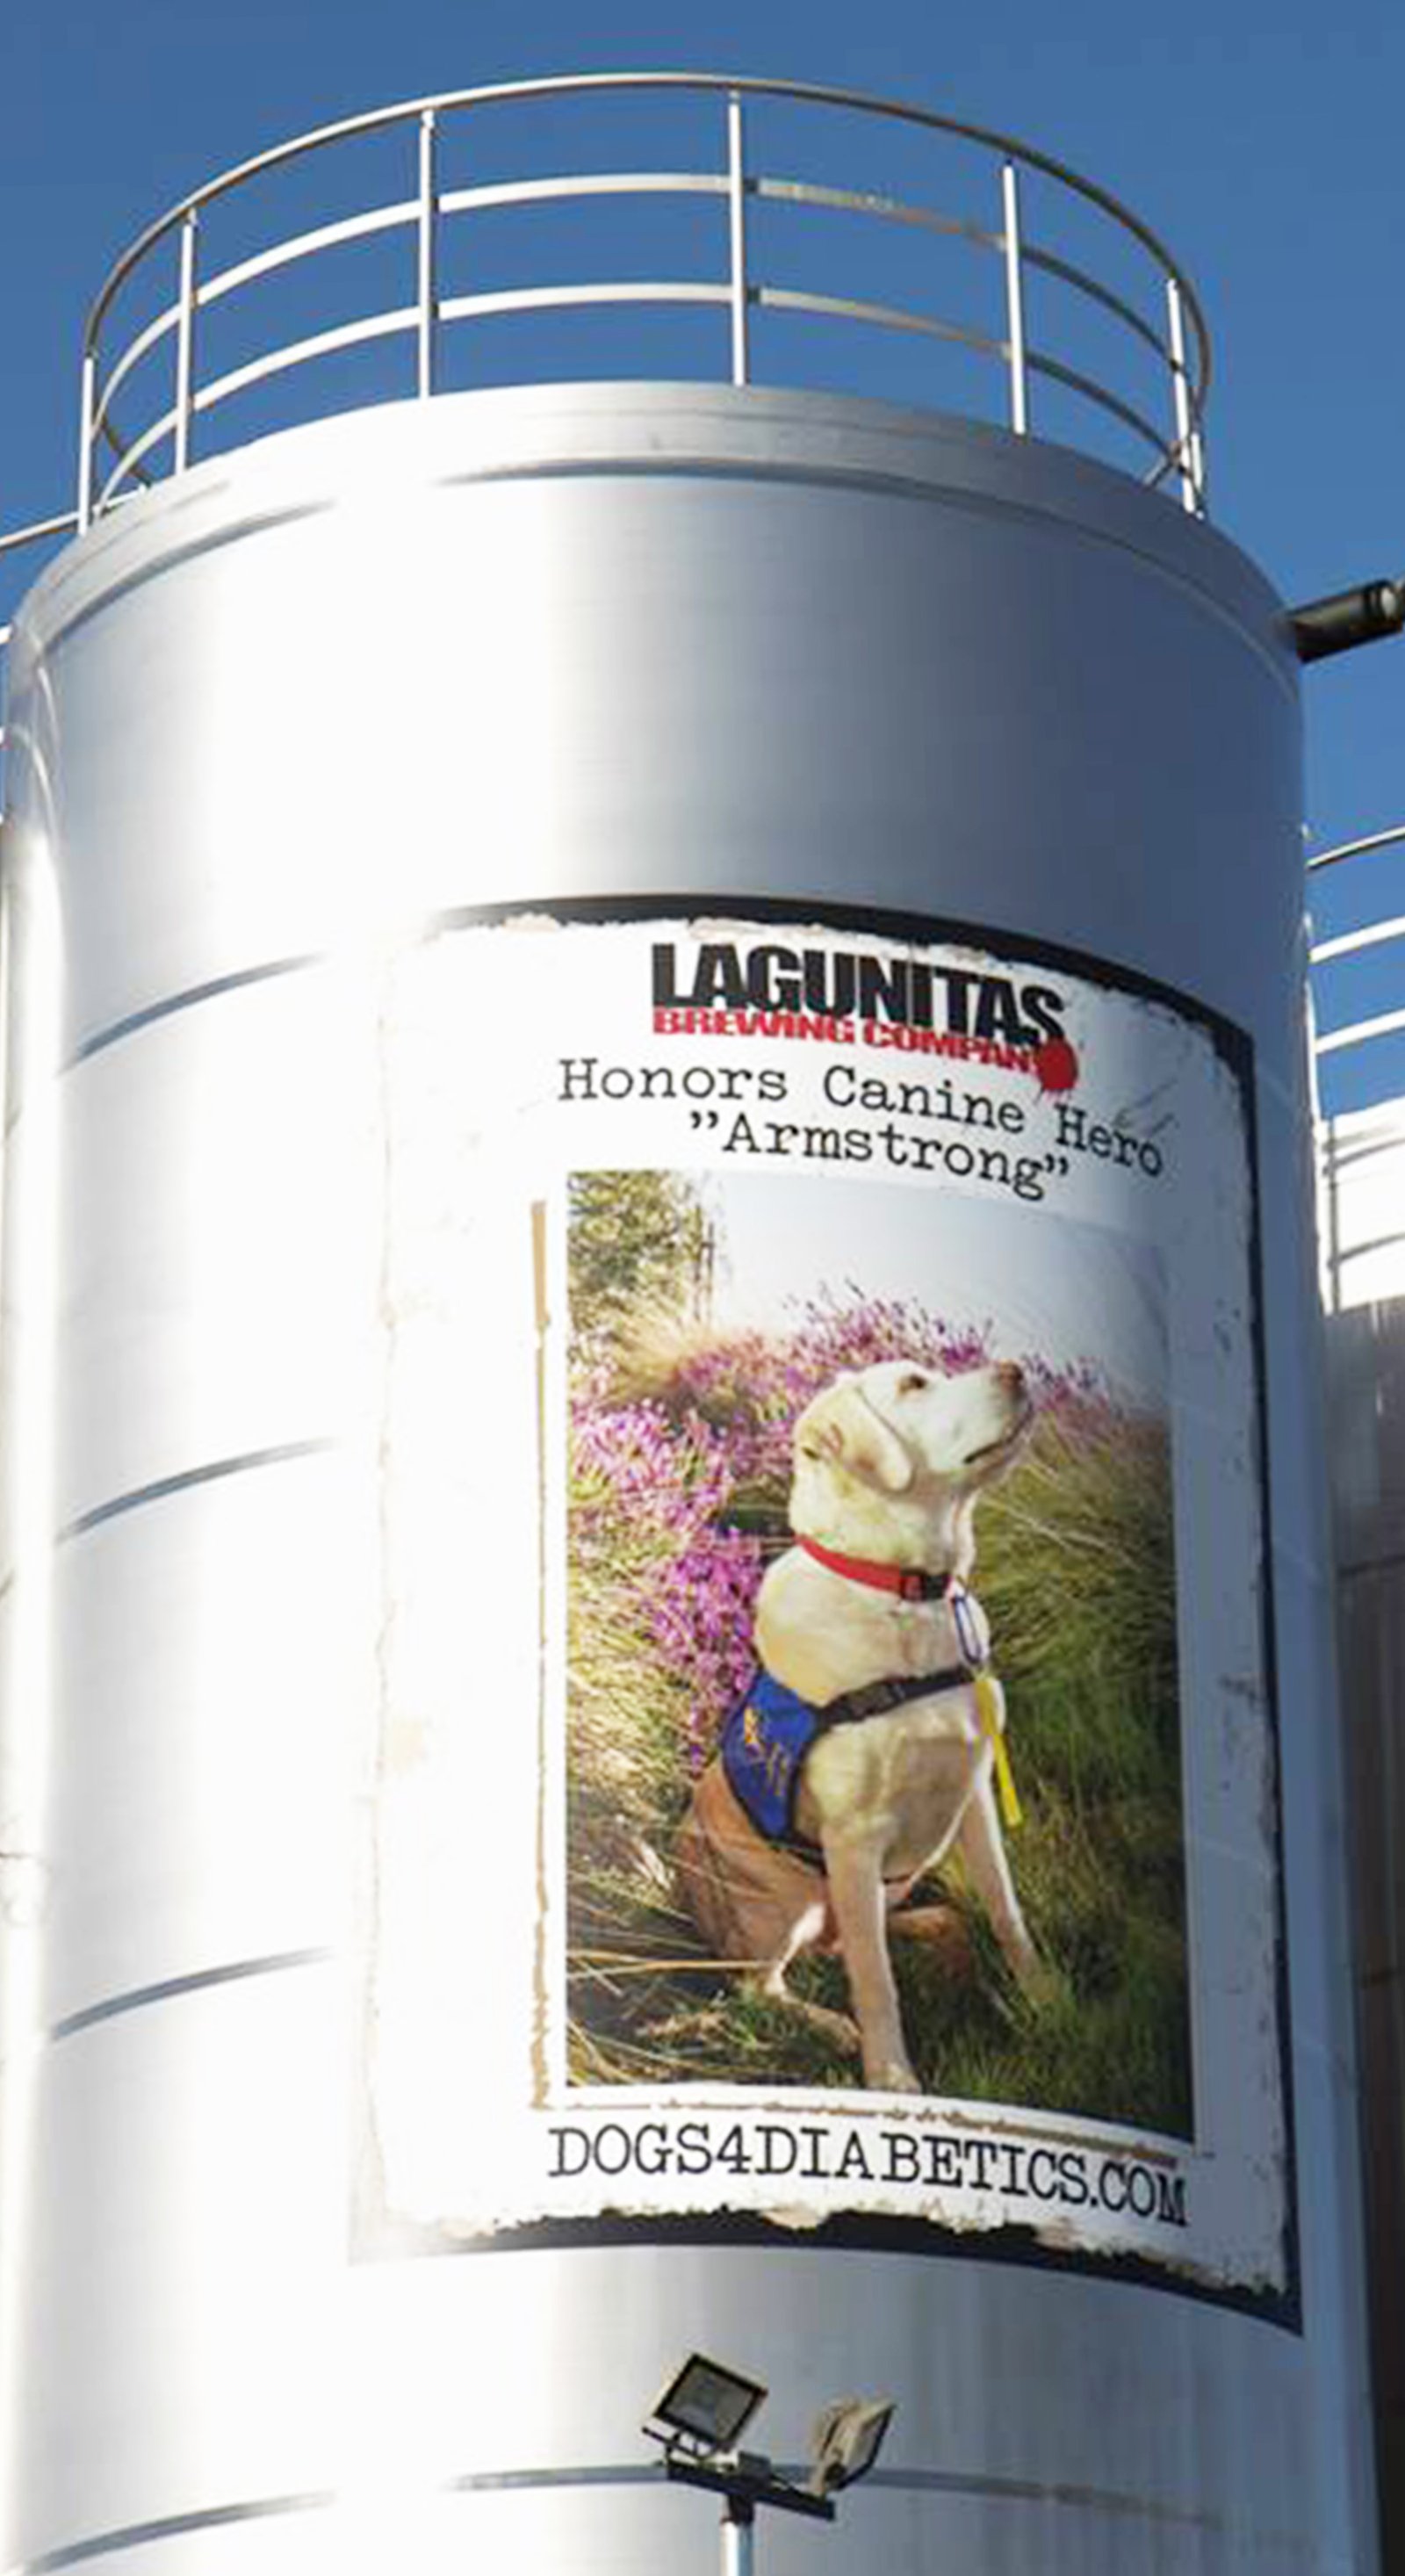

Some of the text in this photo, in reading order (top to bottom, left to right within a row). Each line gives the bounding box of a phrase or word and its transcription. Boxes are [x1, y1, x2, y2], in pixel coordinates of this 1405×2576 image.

[652, 943, 1065, 1047] LAGUNITAS
[652, 1005, 1040, 1073] BREWING COMPAN
[558, 1057, 1164, 1178] Honors Canine Hero
[548, 2124, 1189, 2227] DOGS4DIABETICS.COM
